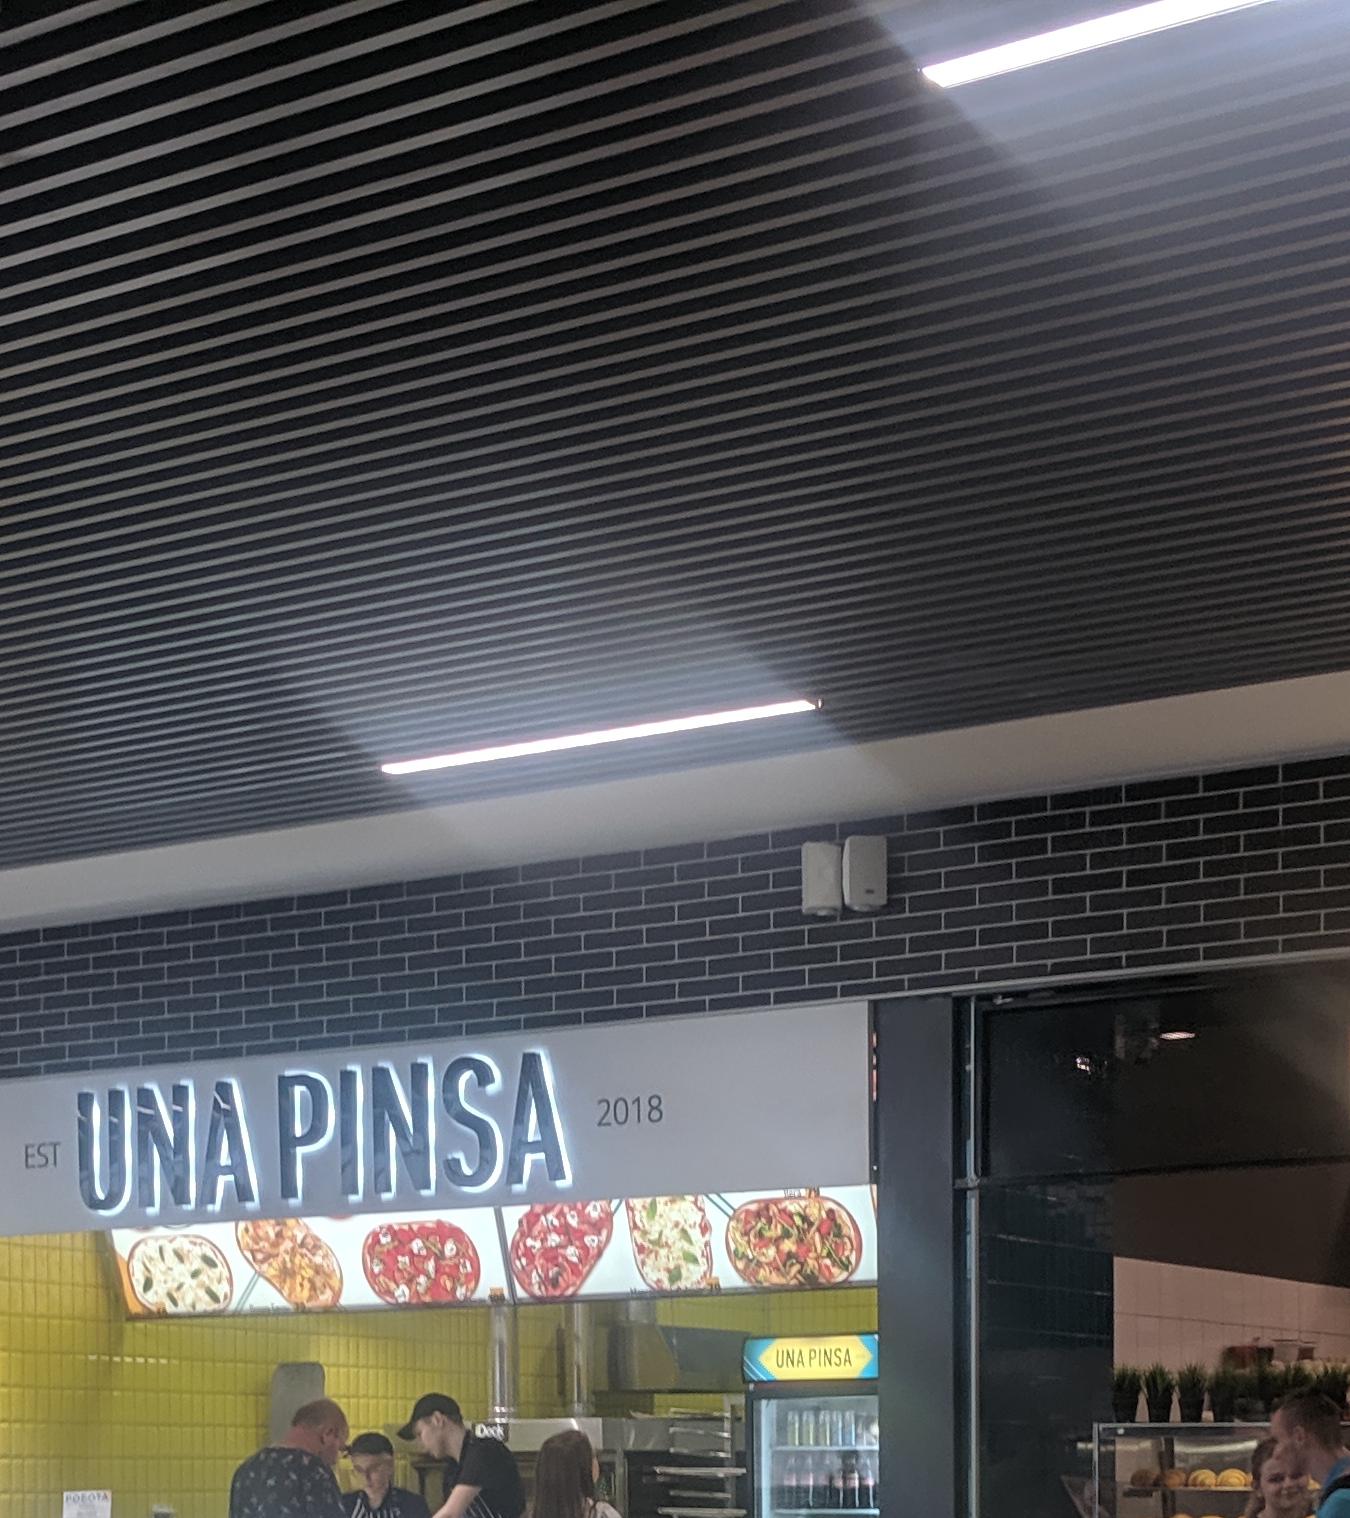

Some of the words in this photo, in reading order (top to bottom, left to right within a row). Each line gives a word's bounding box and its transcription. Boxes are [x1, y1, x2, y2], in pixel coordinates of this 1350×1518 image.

[595, 1094, 664, 1127] 2018
[75, 1078, 259, 1216] UNA
[277, 1047, 572, 1206] PINSA
[23, 1141, 62, 1169] EST
[776, 1348, 806, 1369] UNA
[808, 1347, 853, 1368] PINSA
